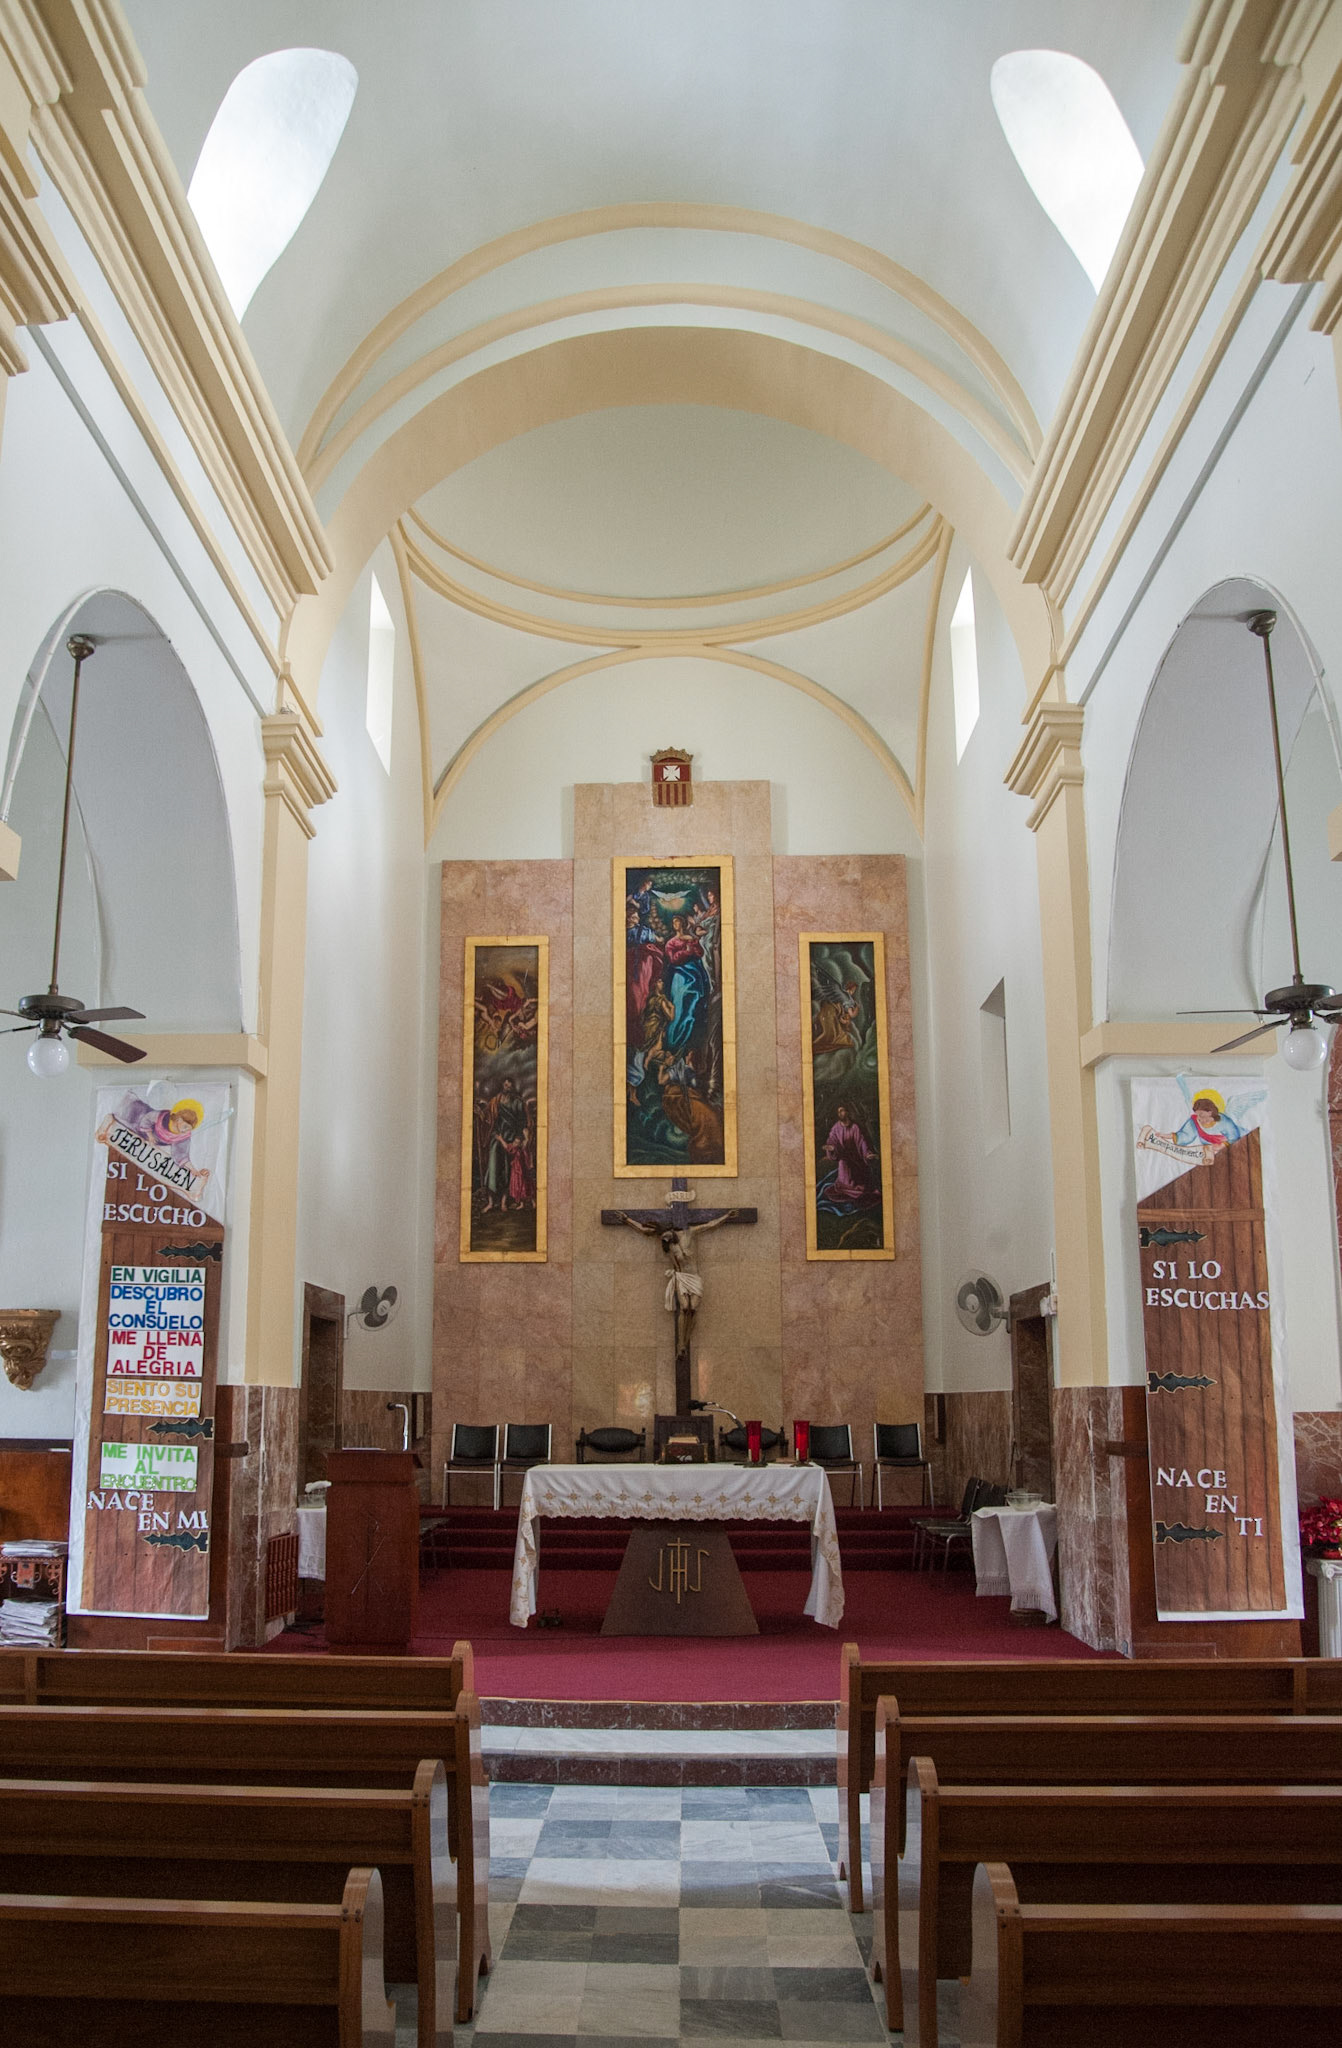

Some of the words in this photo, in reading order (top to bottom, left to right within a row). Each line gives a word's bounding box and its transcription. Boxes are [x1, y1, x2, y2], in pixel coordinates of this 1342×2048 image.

[110, 1128, 196, 1191] JERUSALEN
[107, 1161, 127, 1180] SI
[136, 1174, 168, 1202] LO
[103, 1203, 207, 1228] ESCUCHO
[112, 1267, 135, 1282] EN
[143, 1268, 203, 1283] VIGILIA
[1152, 1260, 1177, 1280] SI
[1188, 1260, 1222, 1279] LO
[111, 1285, 203, 1302] DESCUBRO
[1145, 1287, 1270, 1310] ESCUCHAS
[145, 1300, 167, 1315] EL
[109, 1313, 203, 1330] CONSUELO
[112, 1330, 136, 1346] ME
[145, 1330, 203, 1347] LLENA
[143, 1346, 167, 1360] DE
[112, 1360, 196, 1376] ALEGRIA
[107, 1379, 170, 1397] SIENTO
[175, 1383, 200, 1399] SU
[106, 1398, 200, 1416] PRESENCIA
[103, 1444, 128, 1459] ME
[136, 1446, 196, 1462] INVITA
[134, 1460, 160, 1475] AL
[101, 1474, 197, 1492] ENCUENTRO
[1155, 1467, 1227, 1489] NACE
[87, 1491, 154, 1512] NACE
[1205, 1494, 1238, 1514] EN
[138, 1511, 170, 1532] EN
[177, 1510, 209, 1530] MI
[1234, 1517, 1264, 1536] TI
